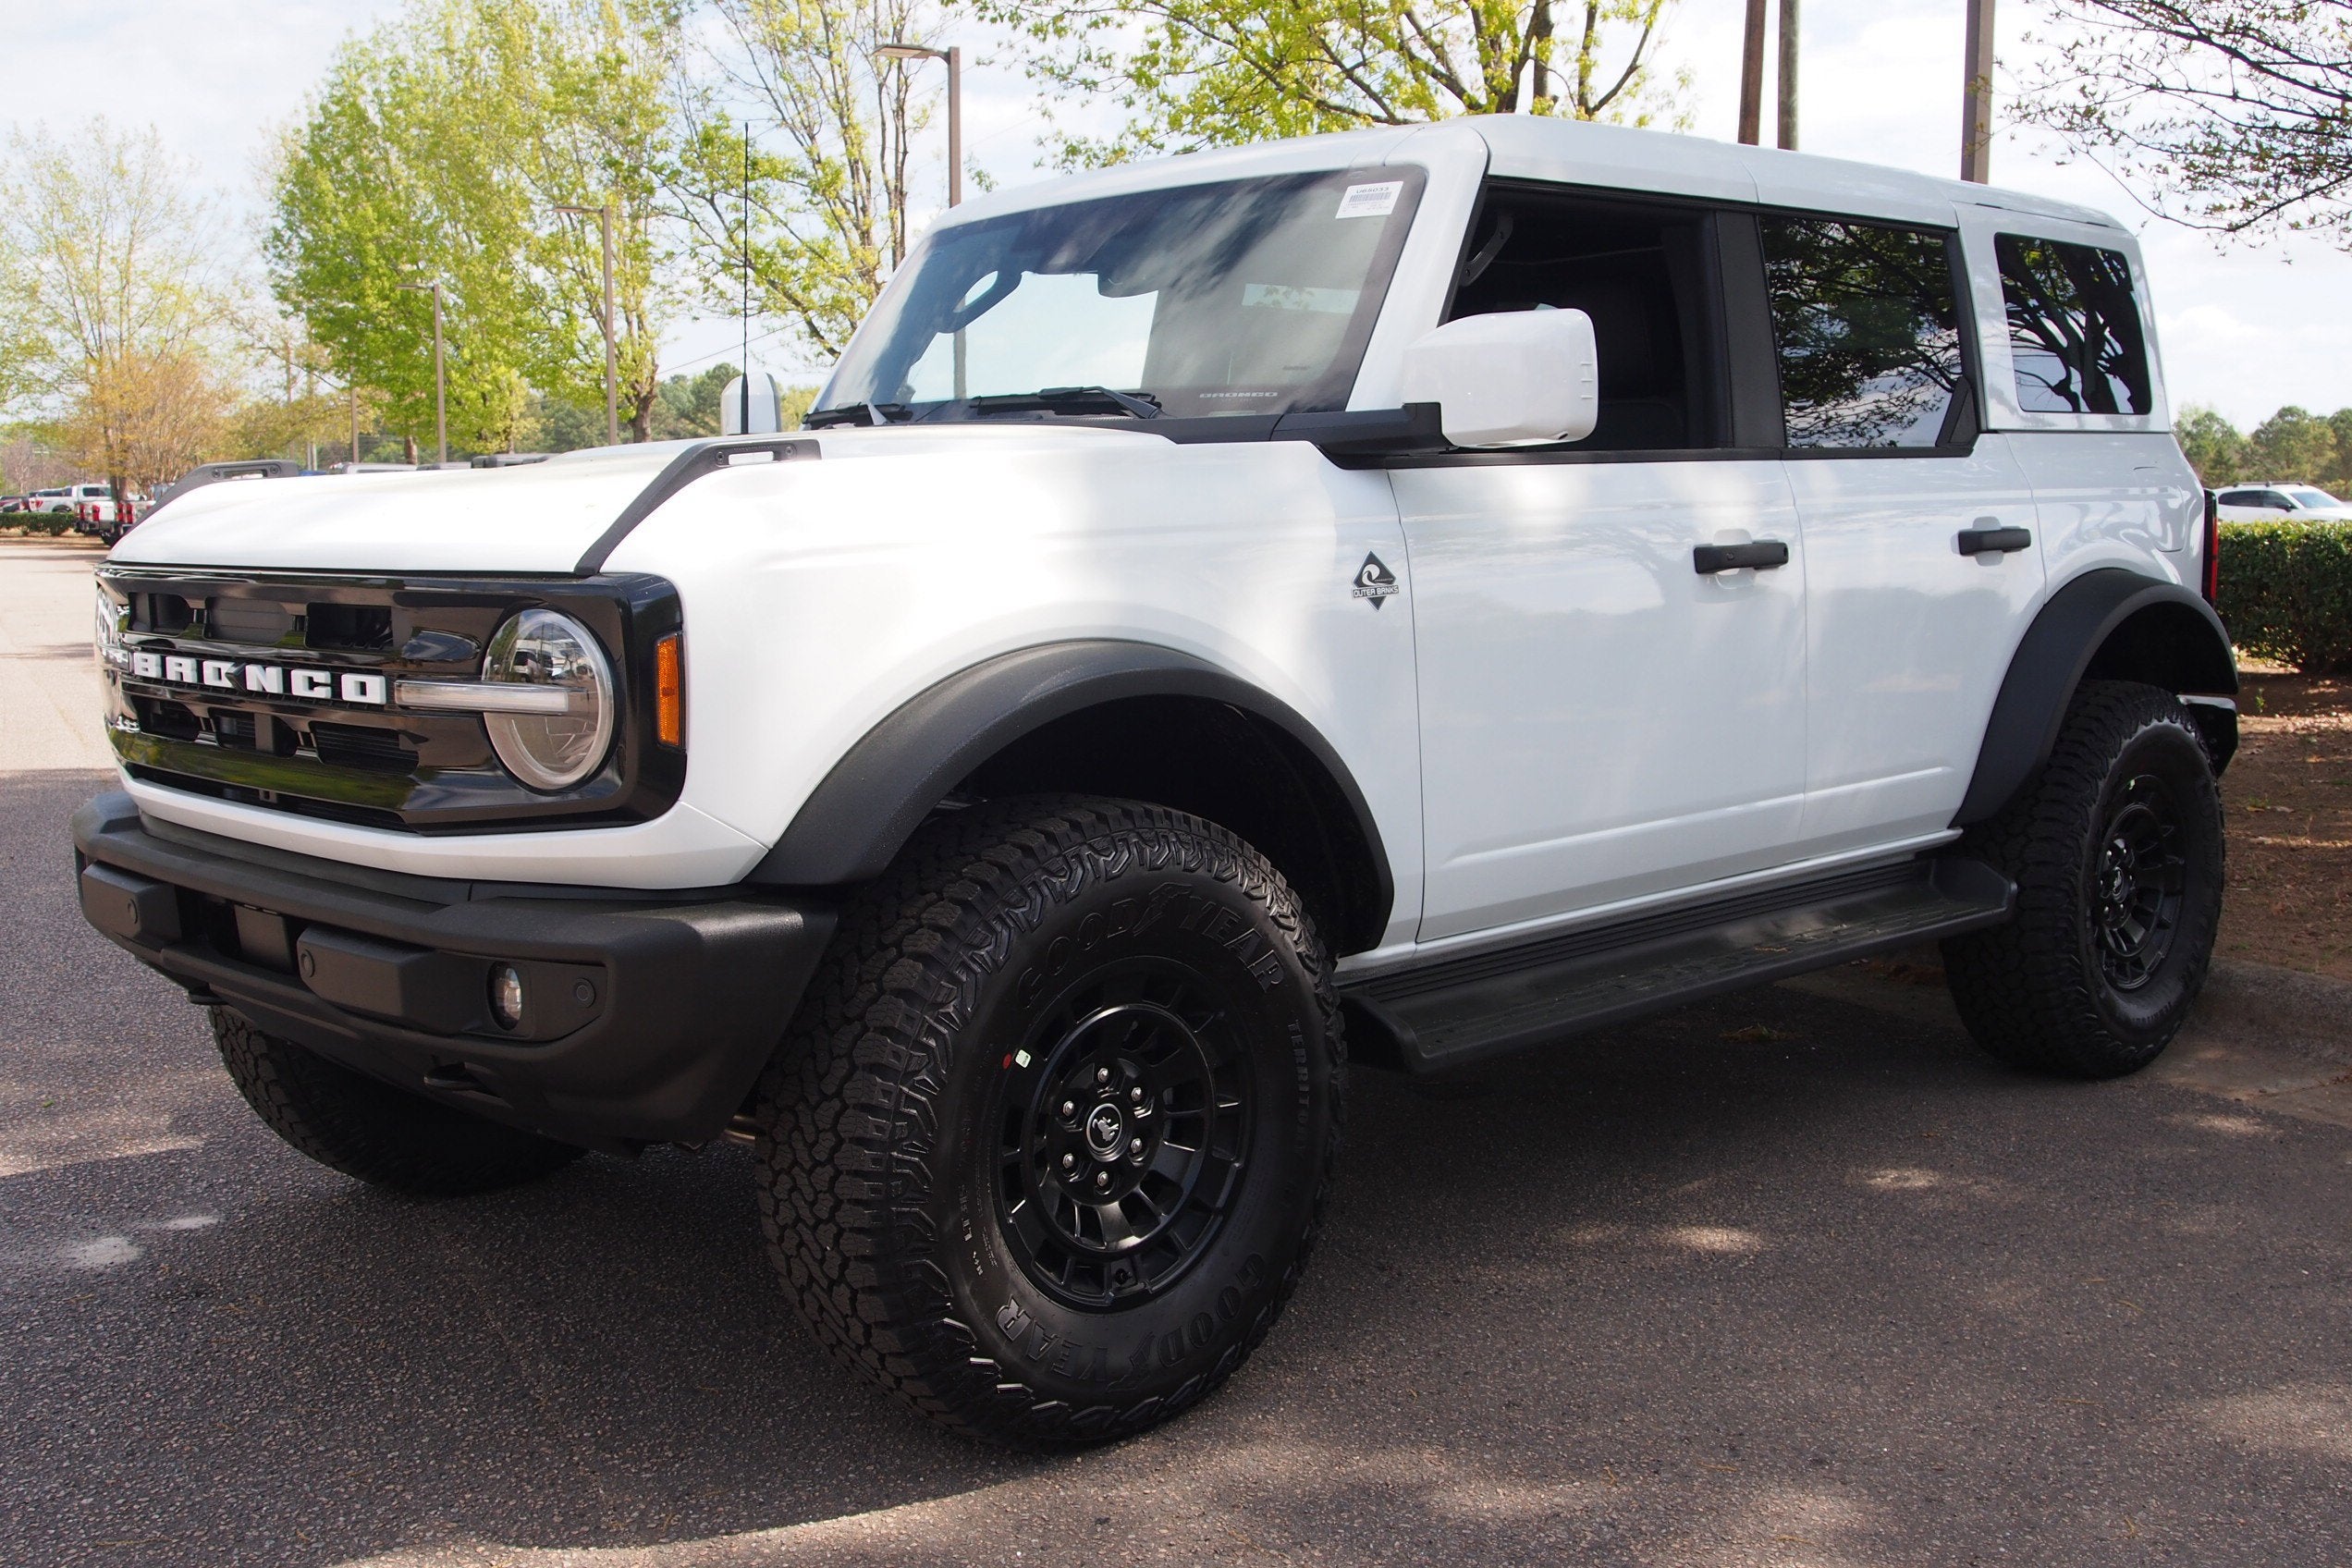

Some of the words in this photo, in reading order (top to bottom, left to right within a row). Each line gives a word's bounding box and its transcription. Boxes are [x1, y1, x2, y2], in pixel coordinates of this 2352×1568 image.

[1354, 588, 1376, 597] OUTER
[1377, 585, 1398, 594] BANKS
[133, 651, 386, 705] BRONCO
